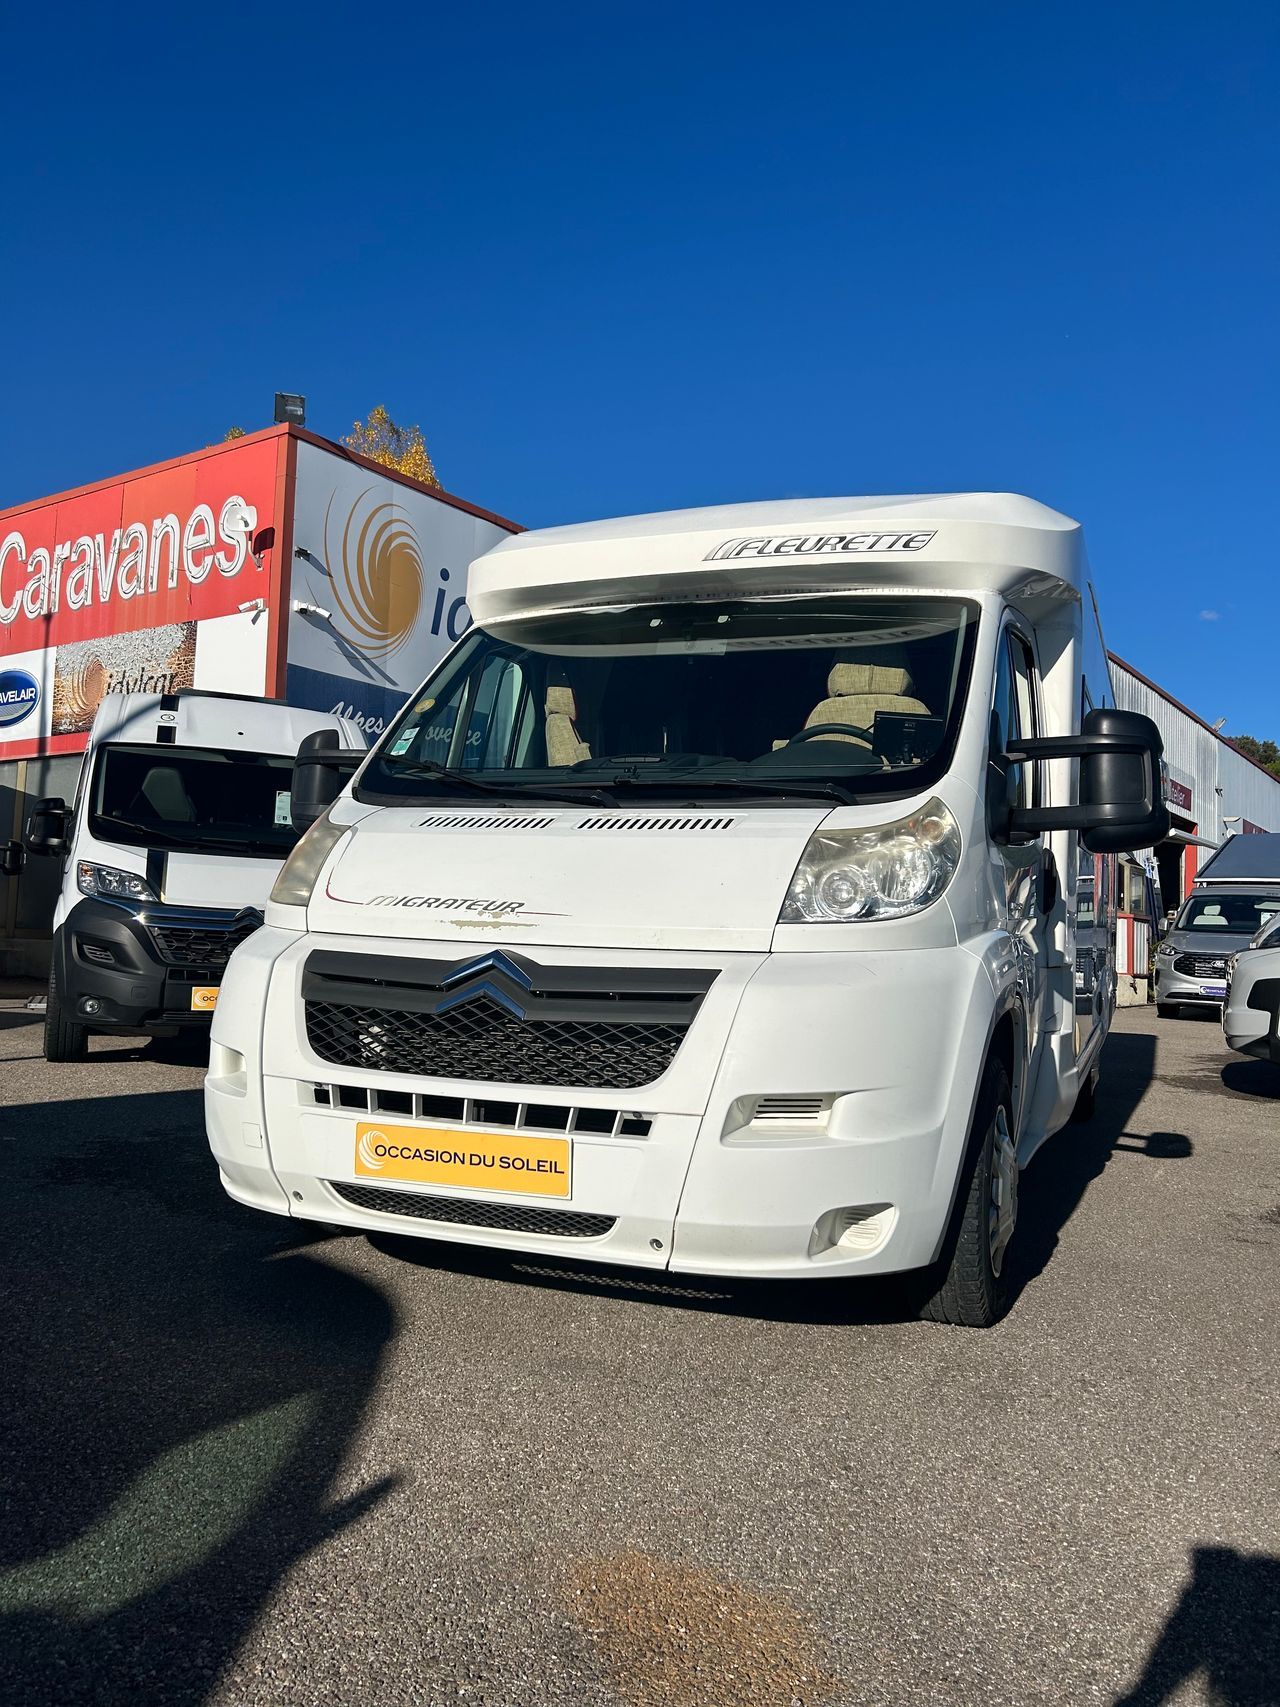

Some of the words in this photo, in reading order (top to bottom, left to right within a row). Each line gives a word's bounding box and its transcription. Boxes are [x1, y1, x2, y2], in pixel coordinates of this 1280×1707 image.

[734, 533, 932, 556] FLEURETTE
[0, 495, 247, 625] Caravanes
[365, 895, 526, 913] MIGRATEUR
[374, 1144, 466, 1165] OCCASION
[469, 1153, 495, 1168] DU
[498, 1156, 565, 1175] SOLEIL
